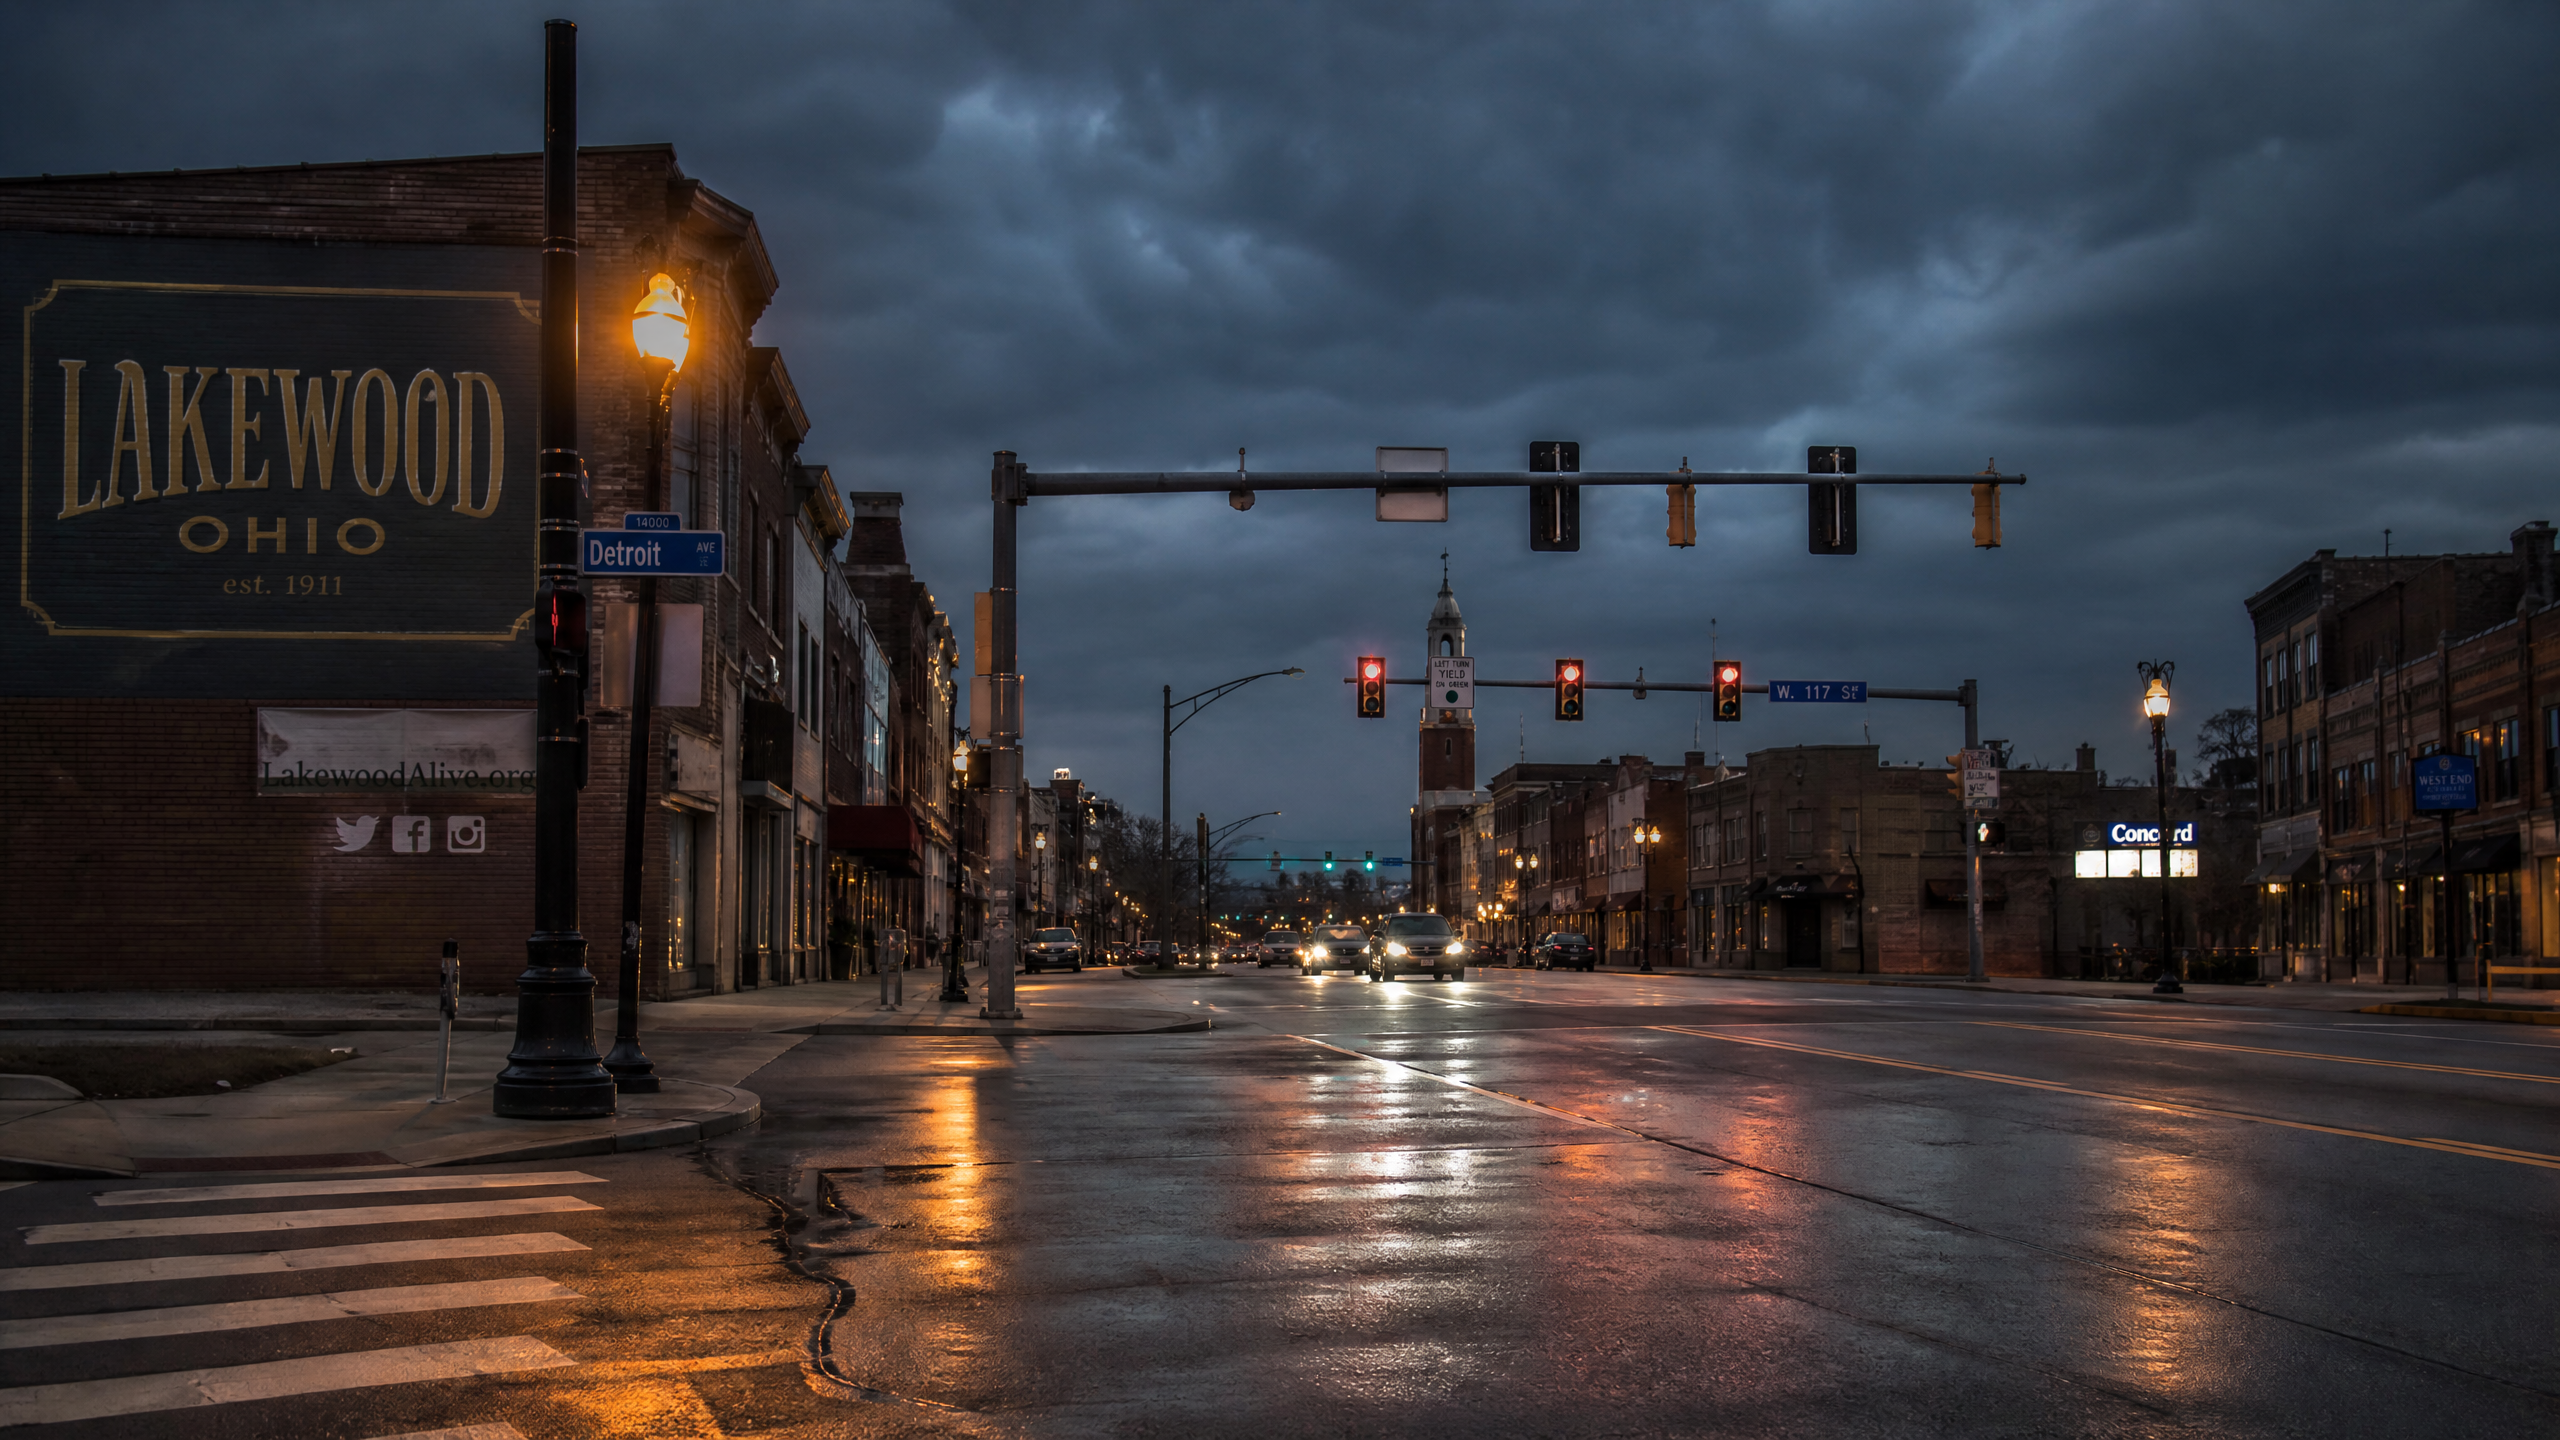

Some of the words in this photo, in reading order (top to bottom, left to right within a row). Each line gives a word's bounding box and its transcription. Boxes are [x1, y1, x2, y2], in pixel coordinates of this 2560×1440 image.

[57, 359, 506, 520] LAKEWOOD
[635, 516, 670, 528] 14000
[179, 515, 386, 556] OHIO
[589, 539, 661, 567] Detroit
[696, 541, 716, 554] AVE
[222, 575, 273, 596] est.
[284, 574, 343, 597] 1911
[1438, 669, 1465, 679] YIELD
[1776, 685, 1795, 699] W.
[1805, 685, 1831, 700] 117
[262, 760, 537, 795] LakewoodAlive.org
[2418, 775, 2447, 786] WEST
[2450, 773, 2472, 785] END
[2111, 823, 2193, 842] Concrd
